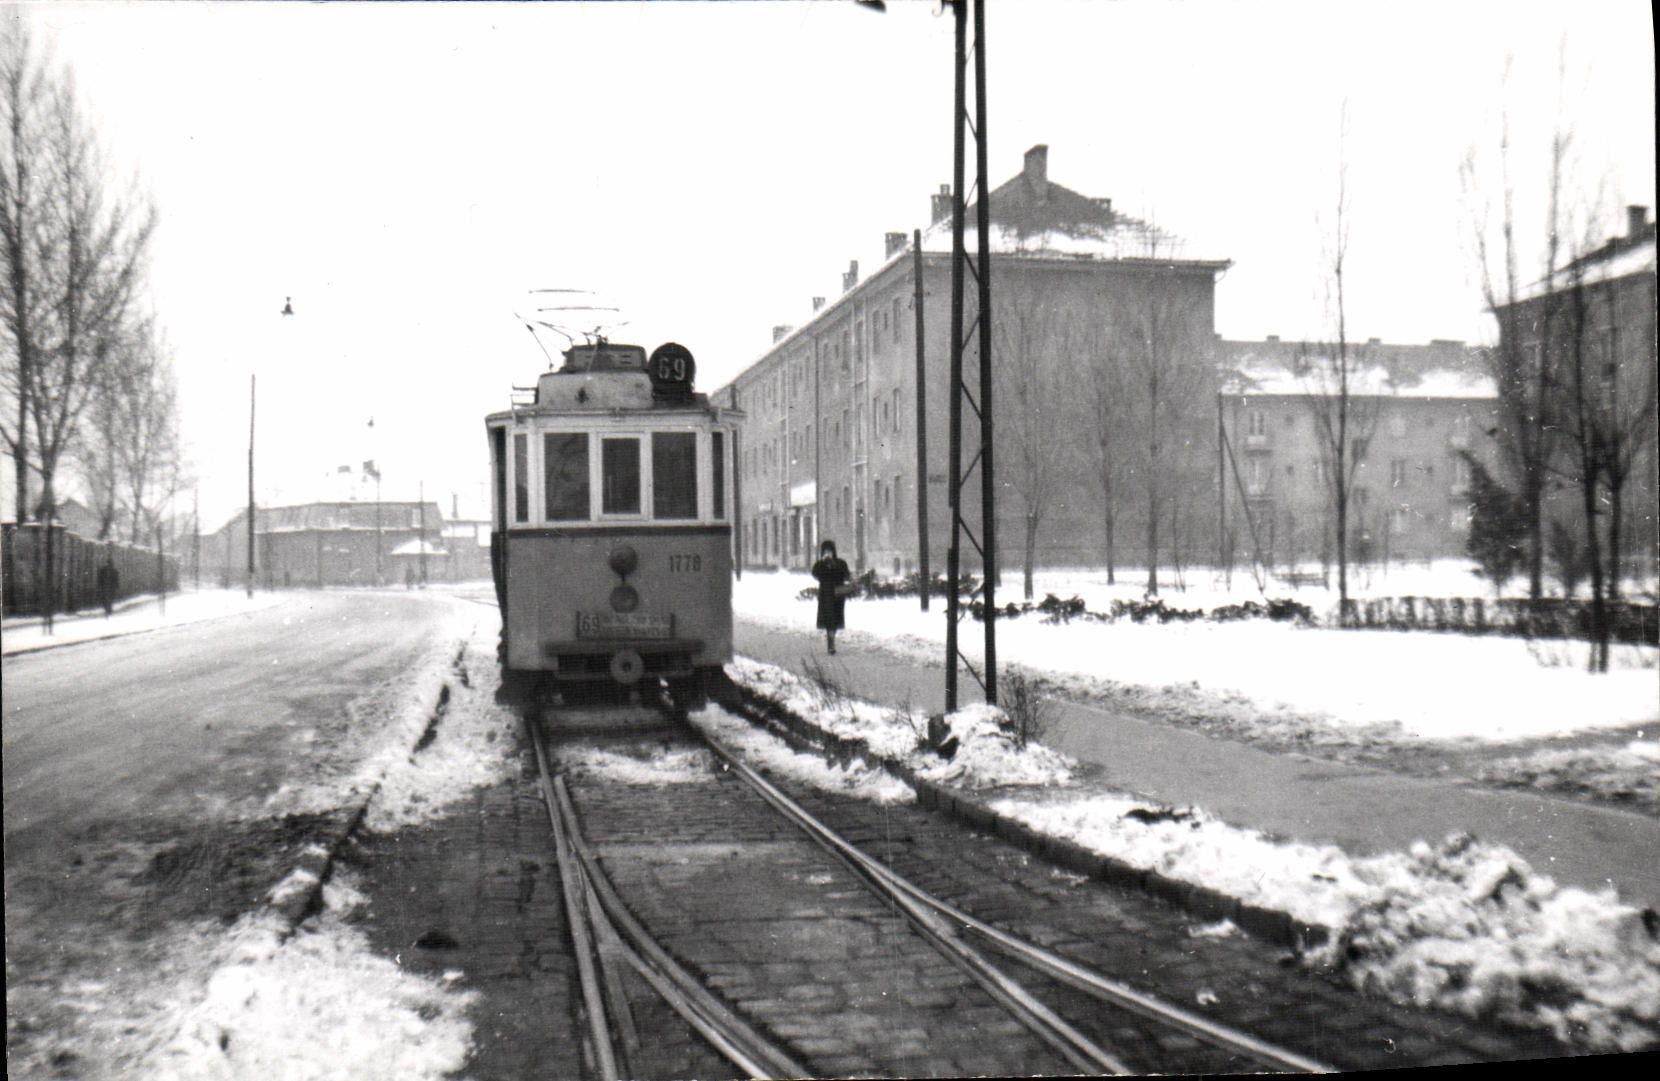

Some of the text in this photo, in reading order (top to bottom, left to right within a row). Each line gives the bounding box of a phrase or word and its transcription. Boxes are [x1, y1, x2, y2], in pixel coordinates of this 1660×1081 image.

[657, 357, 686, 382] 69
[669, 554, 702, 573] 1778
[581, 614, 601, 634] 69
